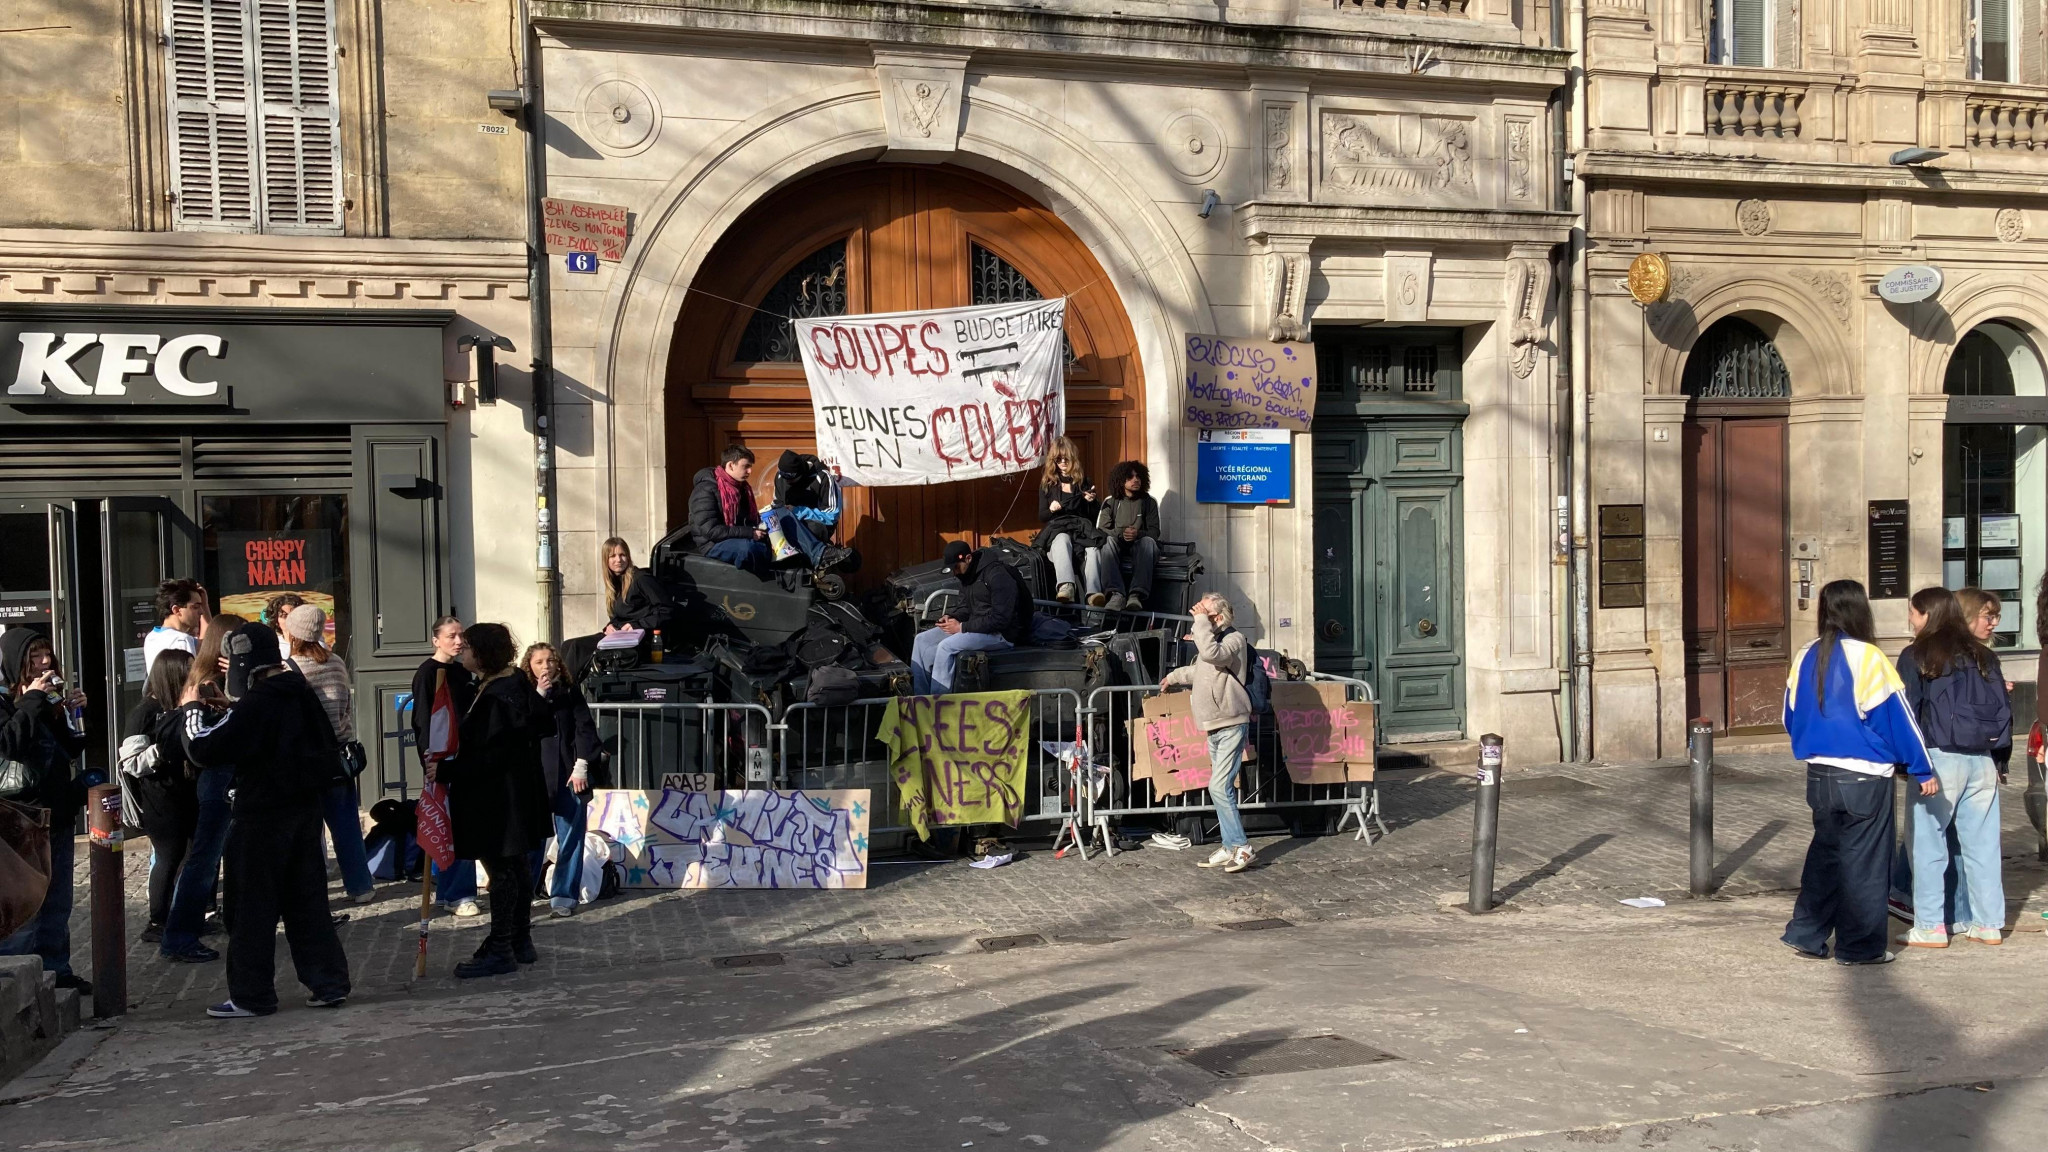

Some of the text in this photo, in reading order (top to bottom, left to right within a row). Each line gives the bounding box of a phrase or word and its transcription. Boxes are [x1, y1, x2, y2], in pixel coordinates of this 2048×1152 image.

[481, 125, 505, 133] 78022
[571, 204, 625, 222] ASSEMBLÉE
[546, 234, 566, 246] OTE:
[566, 236, 599, 252] BLOCUS
[576, 254, 588, 271] 6
[1885, 277, 1934, 289] COMMISSAIRE
[1900, 284, 1928, 293] JUSTICE
[811, 309, 1064, 379] COUPES BUDGETAIRES
[8, 332, 222, 396] KFC
[1187, 337, 1276, 374] BLOCUS
[822, 405, 927, 440] JEUNES
[854, 438, 902, 469] EN
[1215, 465, 1272, 473] LYCÉE RÉGIONAL
[245, 537, 305, 561] CRISPY
[247, 560, 306, 586] NAAN
[663, 773, 707, 792] ACAB
